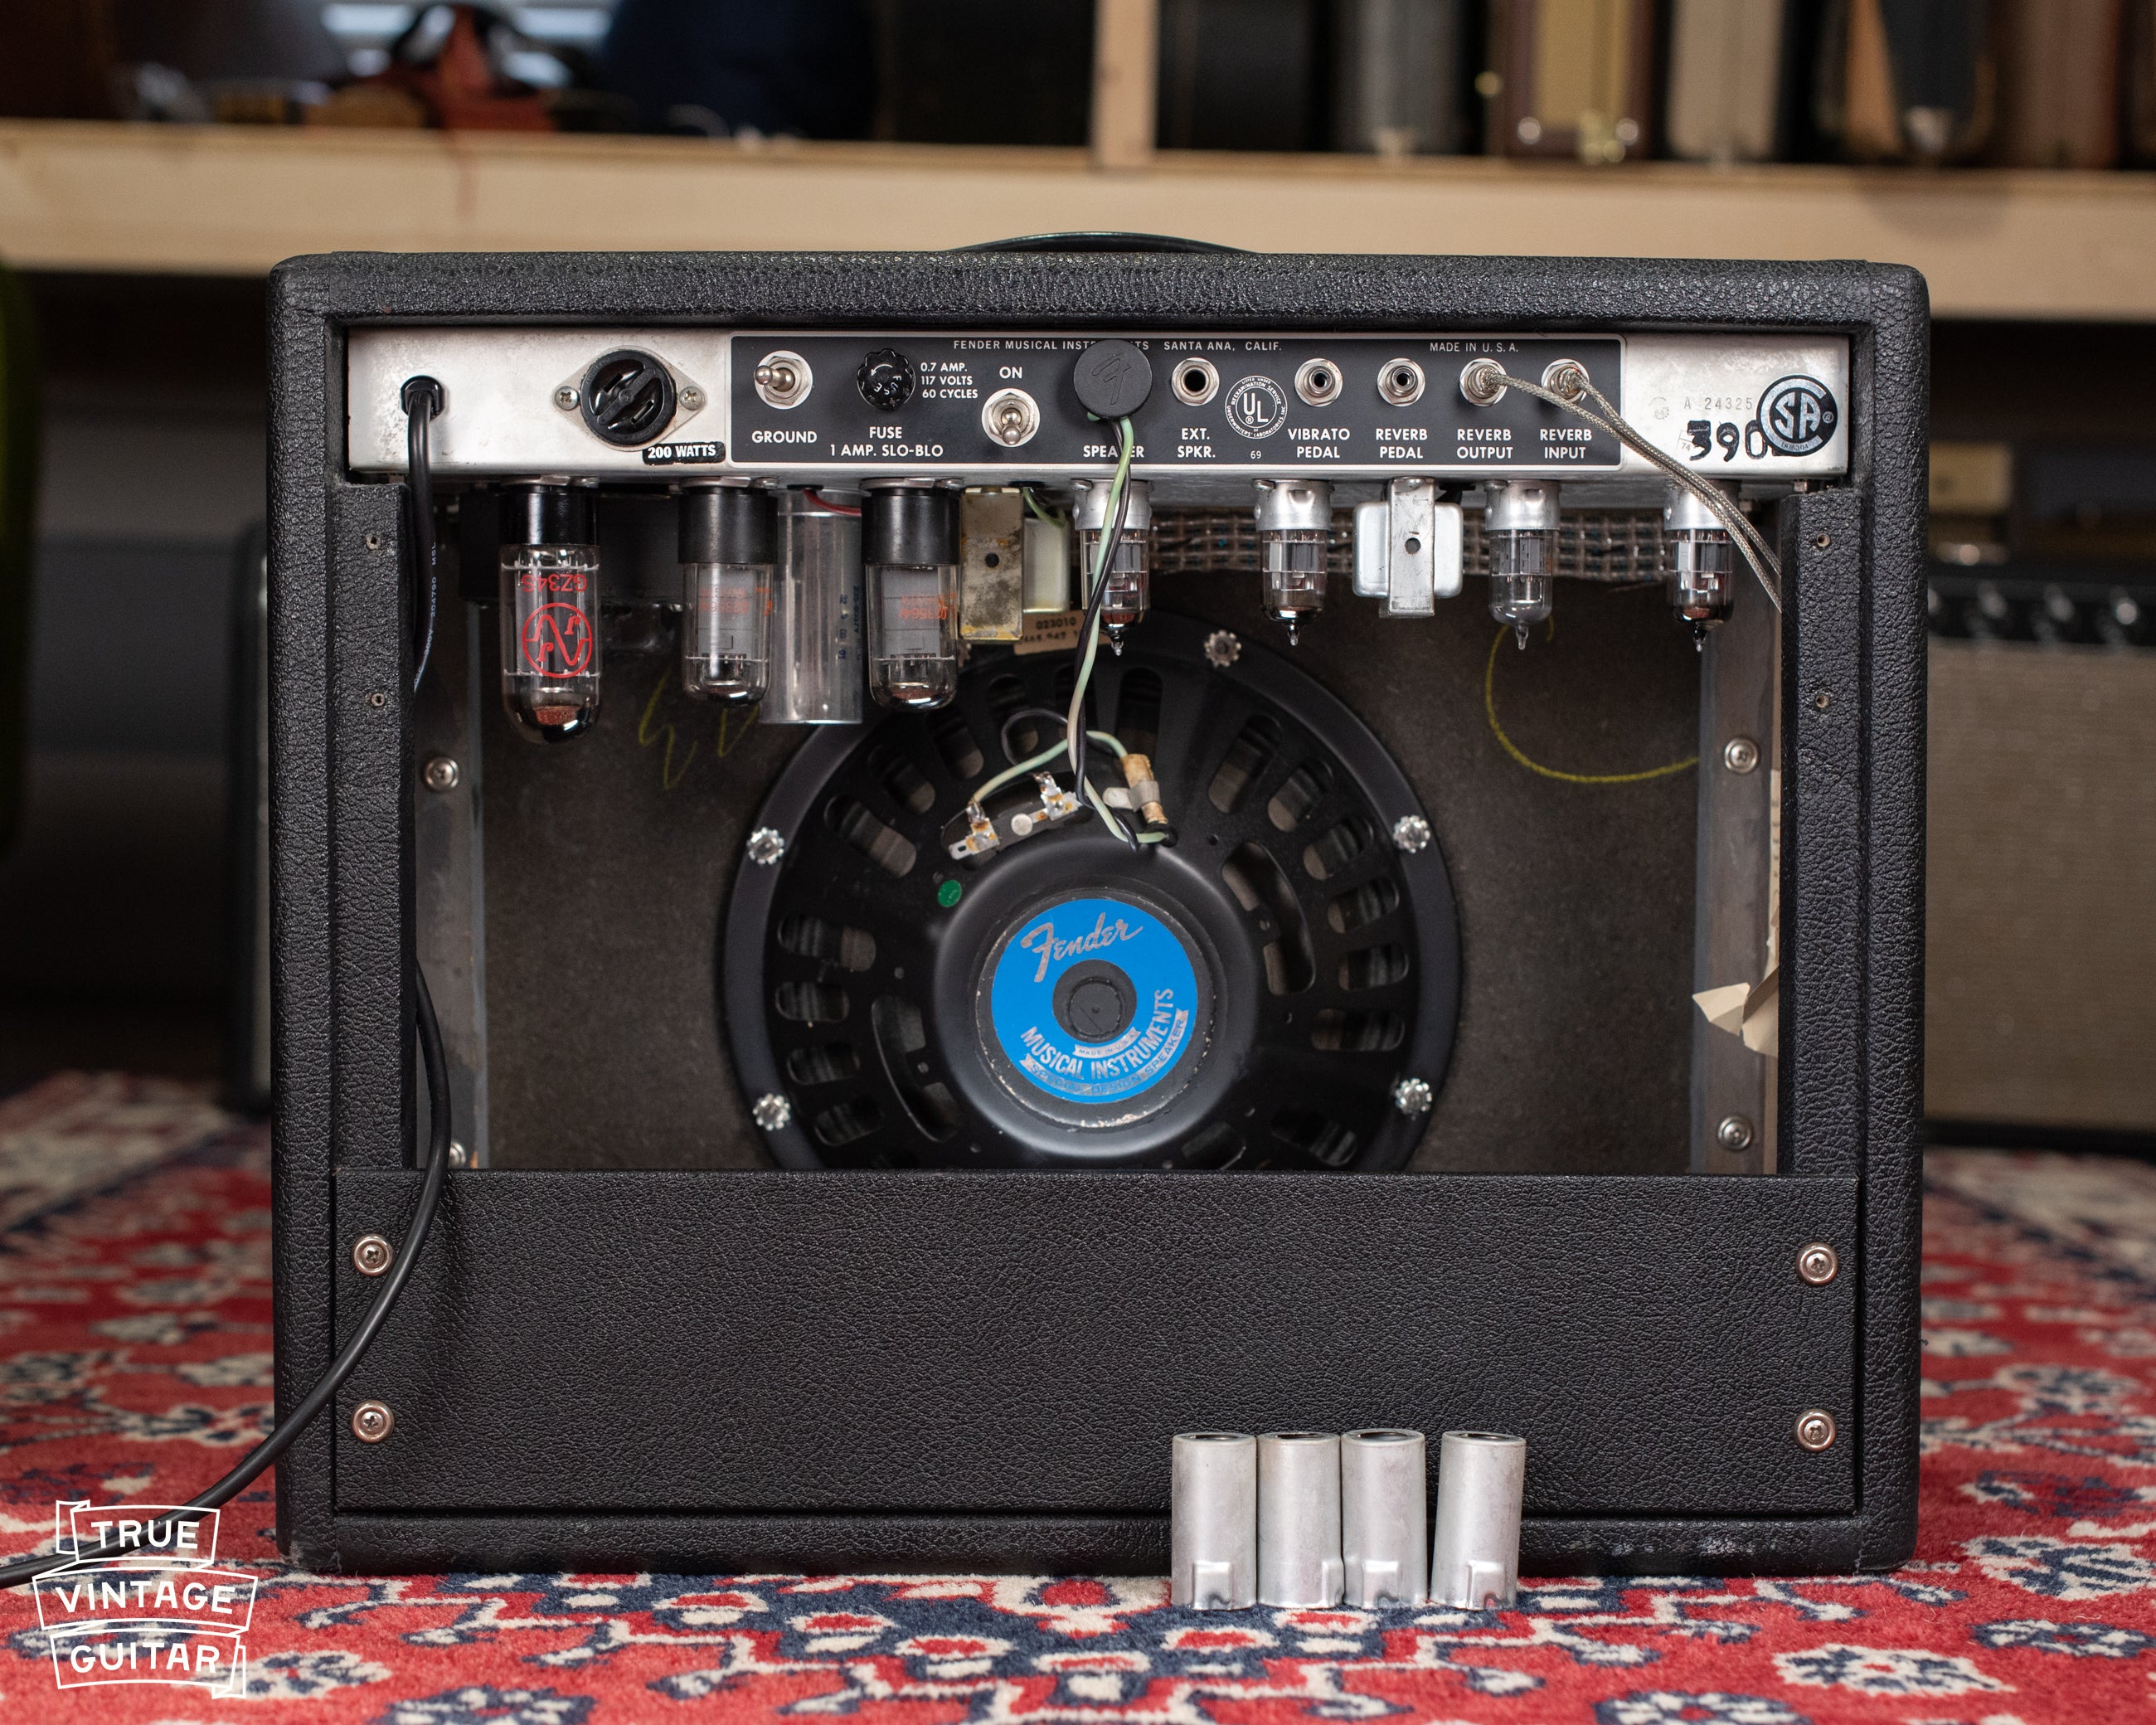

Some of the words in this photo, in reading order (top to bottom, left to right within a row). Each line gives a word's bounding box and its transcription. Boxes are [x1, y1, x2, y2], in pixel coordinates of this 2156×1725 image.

[954, 340, 1000, 350] FENDER
[1005, 340, 1058, 350] MUSICAL
[1062, 341, 1149, 350] INSTTS
[1163, 341, 1202, 351] SANTA
[1207, 341, 1236, 352] ANA,
[1245, 341, 1282, 351] CALIF.
[1430, 342, 1460, 352] MADE
[1465, 342, 1477, 352] IN
[920, 362, 937, 372] 0.7
[940, 362, 968, 372] AMP.
[998, 366, 1022, 379] ON
[920, 375, 936, 386] 117
[939, 375, 974, 386] VOLTS
[922, 388, 937, 399] 60
[940, 388, 978, 399] CYCLES
[1704, 397, 1753, 411] 24325
[751, 430, 818, 444] GROUND
[869, 425, 902, 440] FUSE
[1181, 427, 1211, 440] EXT.
[1287, 427, 1351, 441] VIBRATO
[1376, 428, 1428, 441] REVERB
[1457, 428, 1512, 441] REVERB
[1540, 428, 1593, 441] REVERB
[646, 444, 673, 459] 200
[674, 444, 716, 458] WATTS
[830, 444, 835, 456] 1
[840, 444, 876, 457] AMP.
[881, 444, 944, 458] SLO-BLO
[1083, 445, 1144, 458] SPEAER
[1177, 445, 1216, 459] SPKR.
[1250, 450, 1262, 459] 69
[1296, 445, 1341, 459] PEDAL
[1379, 445, 1424, 459] PEDAL
[1456, 446, 1513, 459] OUTPUT
[1544, 446, 1586, 459] INPUT
[521, 574, 588, 593] GZ34S
[1020, 912, 1144, 983] Fender
[1020, 1026, 1085, 1080] MUSICAL
[1090, 988, 1174, 1080] INSTRUMENTS
[1144, 1019, 1184, 1074] SPEAKER
